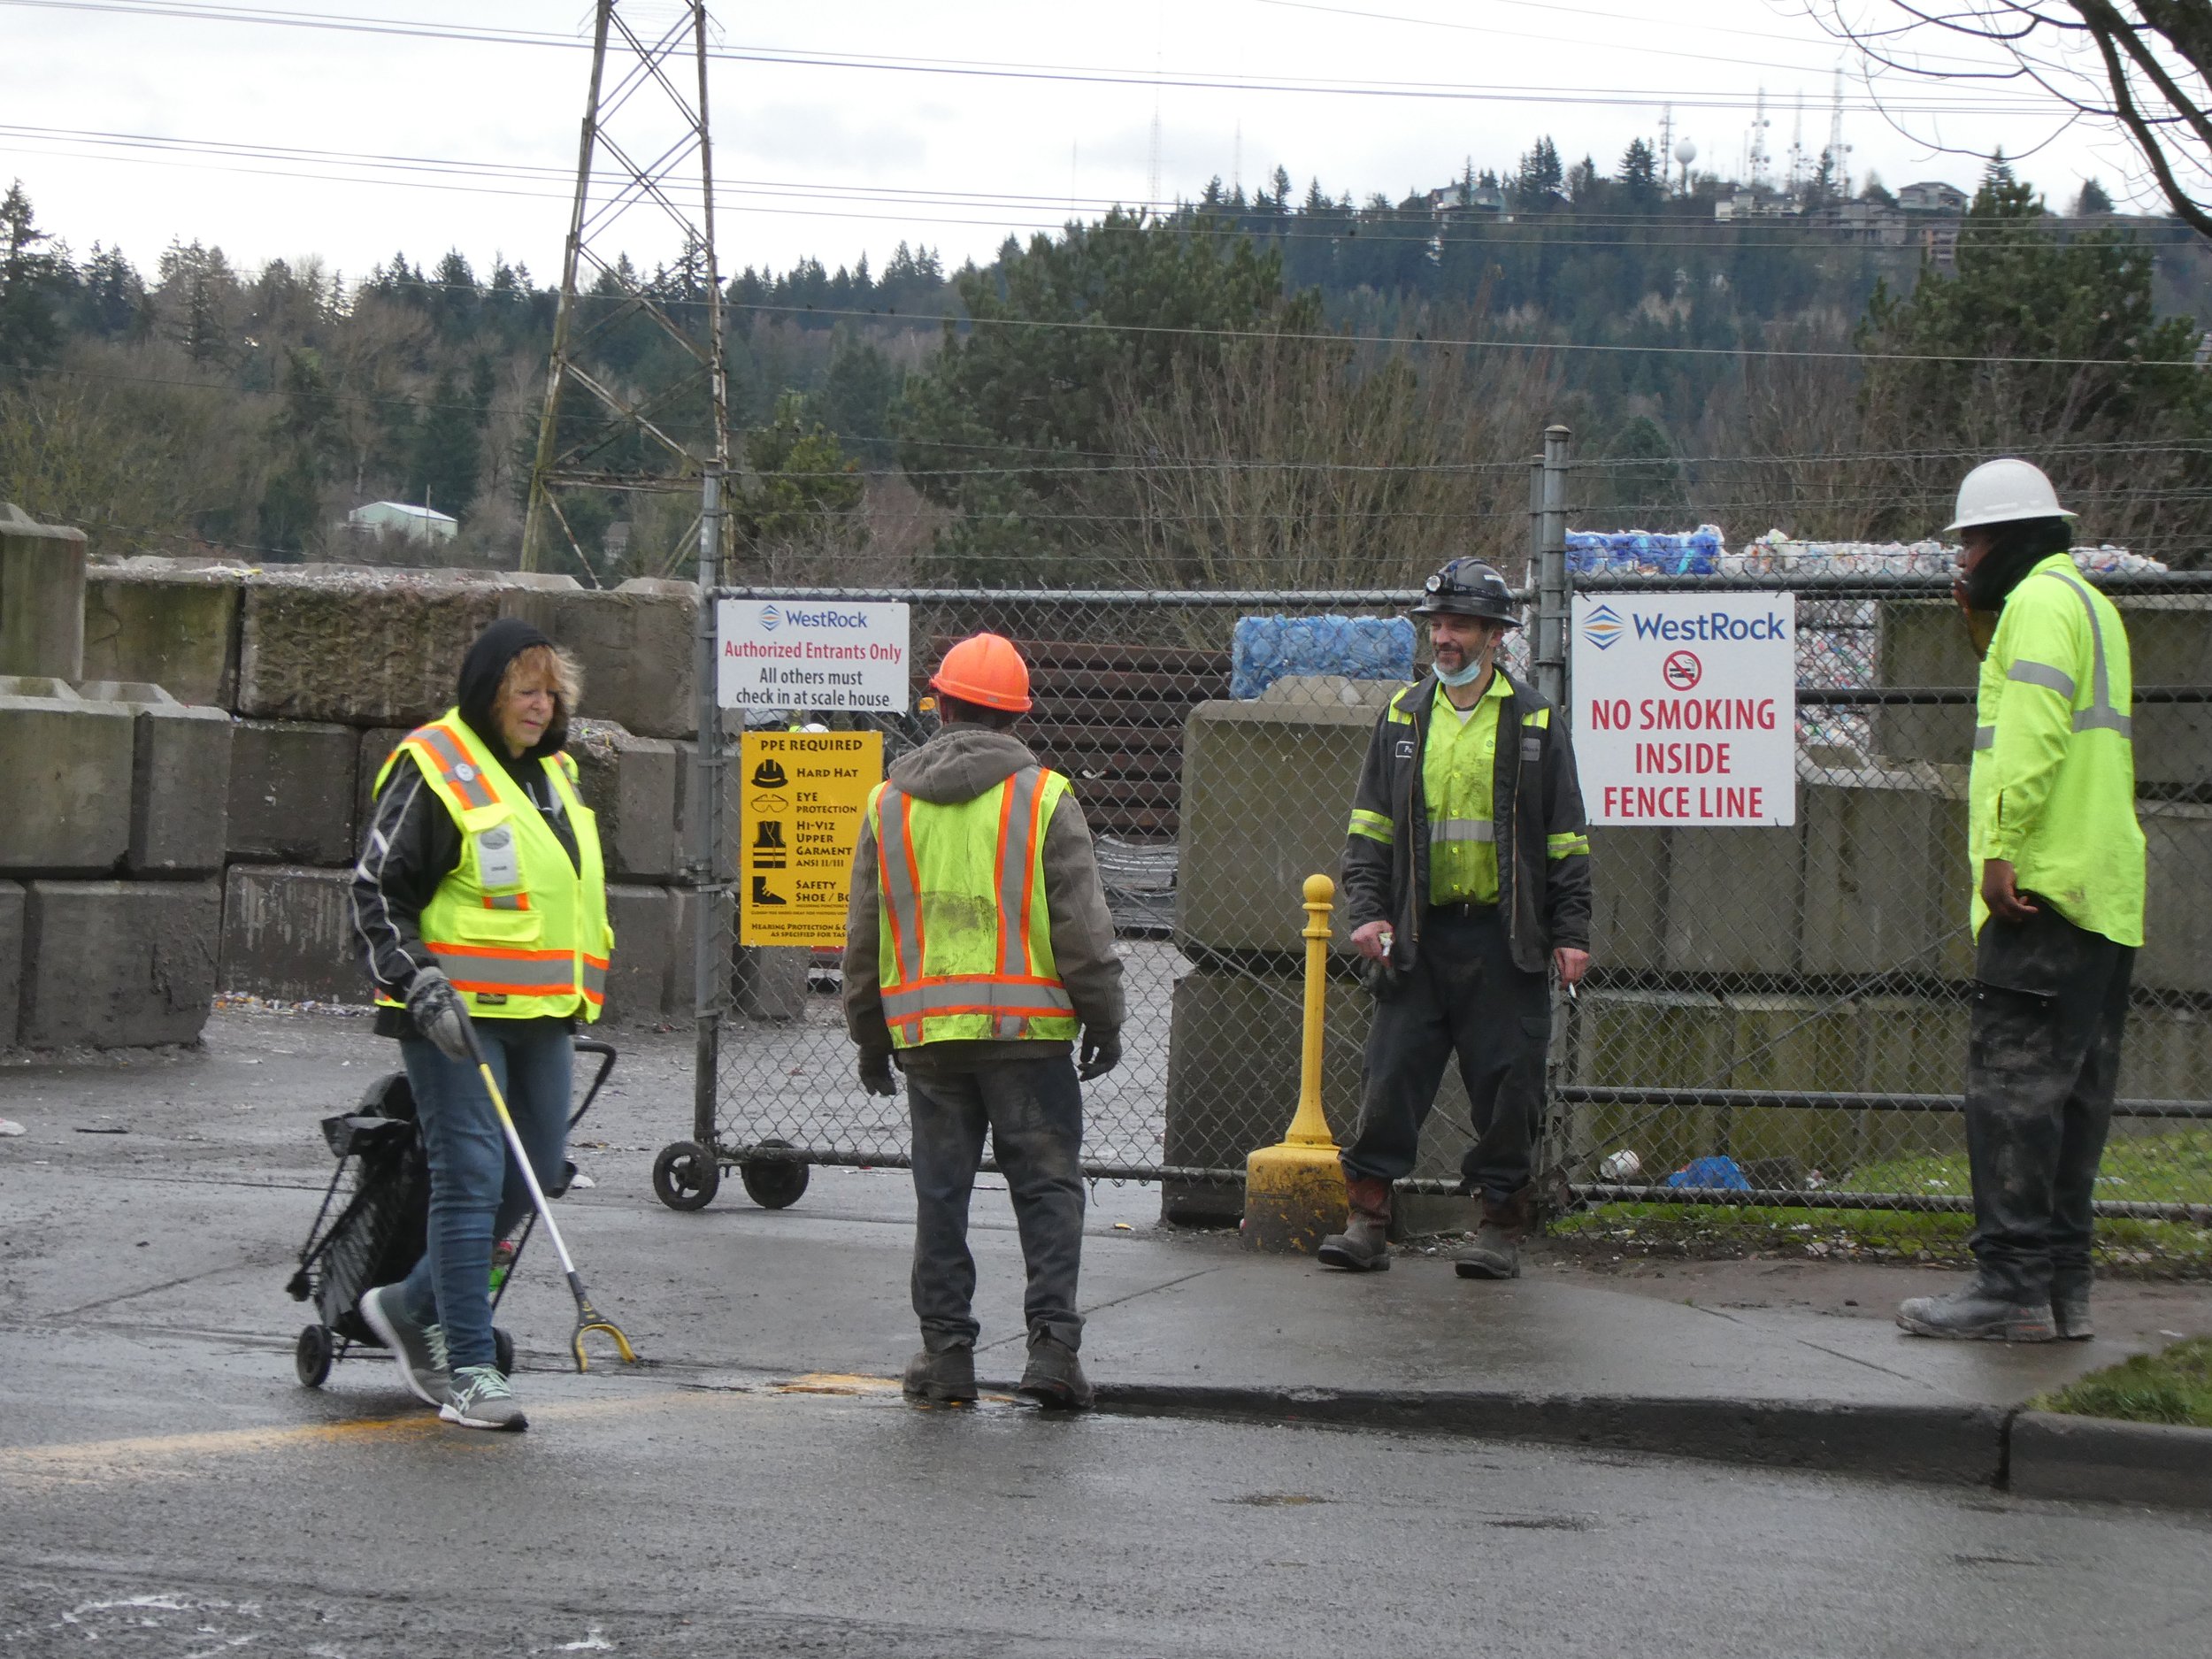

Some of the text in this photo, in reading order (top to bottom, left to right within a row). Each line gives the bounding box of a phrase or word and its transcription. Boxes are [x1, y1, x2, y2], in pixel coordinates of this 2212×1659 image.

[786, 610, 867, 628] WestRock
[1632, 611, 1786, 641] WestRock
[725, 641, 902, 664] Authorized Entrants Only
[759, 667, 863, 686] All others must
[736, 687, 773, 704] check
[778, 689, 790, 704] in
[794, 692, 808, 705] at
[811, 690, 844, 706] scale
[1592, 698, 1776, 730] NO SMOKING
[761, 739, 863, 752] PPE REQUIRED
[1636, 742, 1731, 774] INSIDE
[796, 792, 818, 802] EYE
[1604, 787, 1763, 818] FENCE LINE
[796, 805, 857, 814] PROTECTION
[796, 833, 833, 842] UPPER
[796, 846, 852, 856] GARMENT
[796, 880, 836, 889] SAFETY
[795, 893, 826, 902] SHOE
